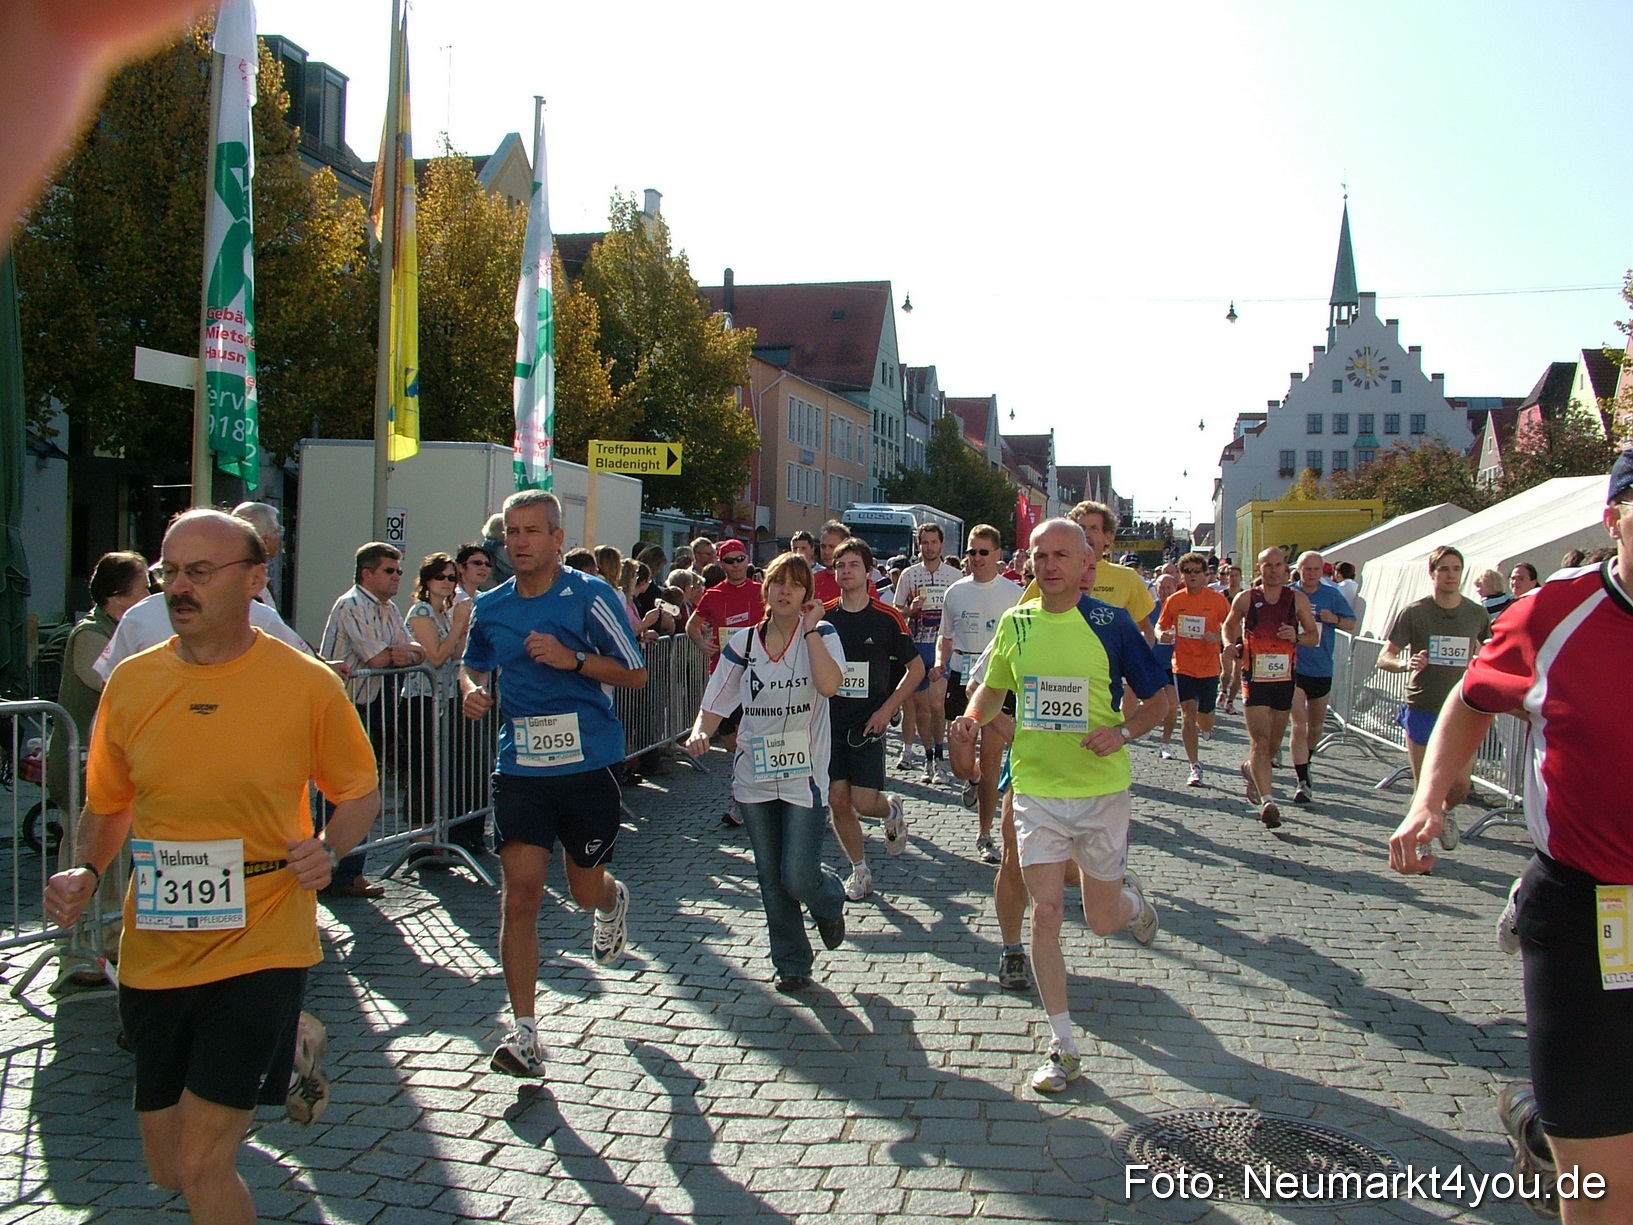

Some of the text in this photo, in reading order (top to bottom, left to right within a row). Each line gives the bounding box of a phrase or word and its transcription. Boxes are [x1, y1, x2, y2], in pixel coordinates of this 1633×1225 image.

[206, 306, 246, 326] Gebä
[596, 443, 657, 456] Treffpunkt
[596, 457, 660, 471] Bladenight
[1187, 625, 1201, 633] 143
[1441, 646, 1466, 657] 3367
[1268, 663, 1284, 671] 654
[770, 676, 808, 690] PLAST
[841, 677, 865, 688] 878
[1040, 681, 1083, 693] Alexander
[745, 703, 811, 717] RUNNING TEAM
[1041, 700, 1083, 717] 2926
[528, 717, 558, 727] Günter
[532, 732, 575, 750] 2059
[767, 739, 786, 748] Luisa
[770, 751, 805, 768] 3070
[160, 849, 210, 866] Helmut
[140, 872, 148, 886] A
[164, 877, 232, 905] 3191
[200, 914, 244, 924] PFLEIDERER
[1603, 924, 1612, 939] B
